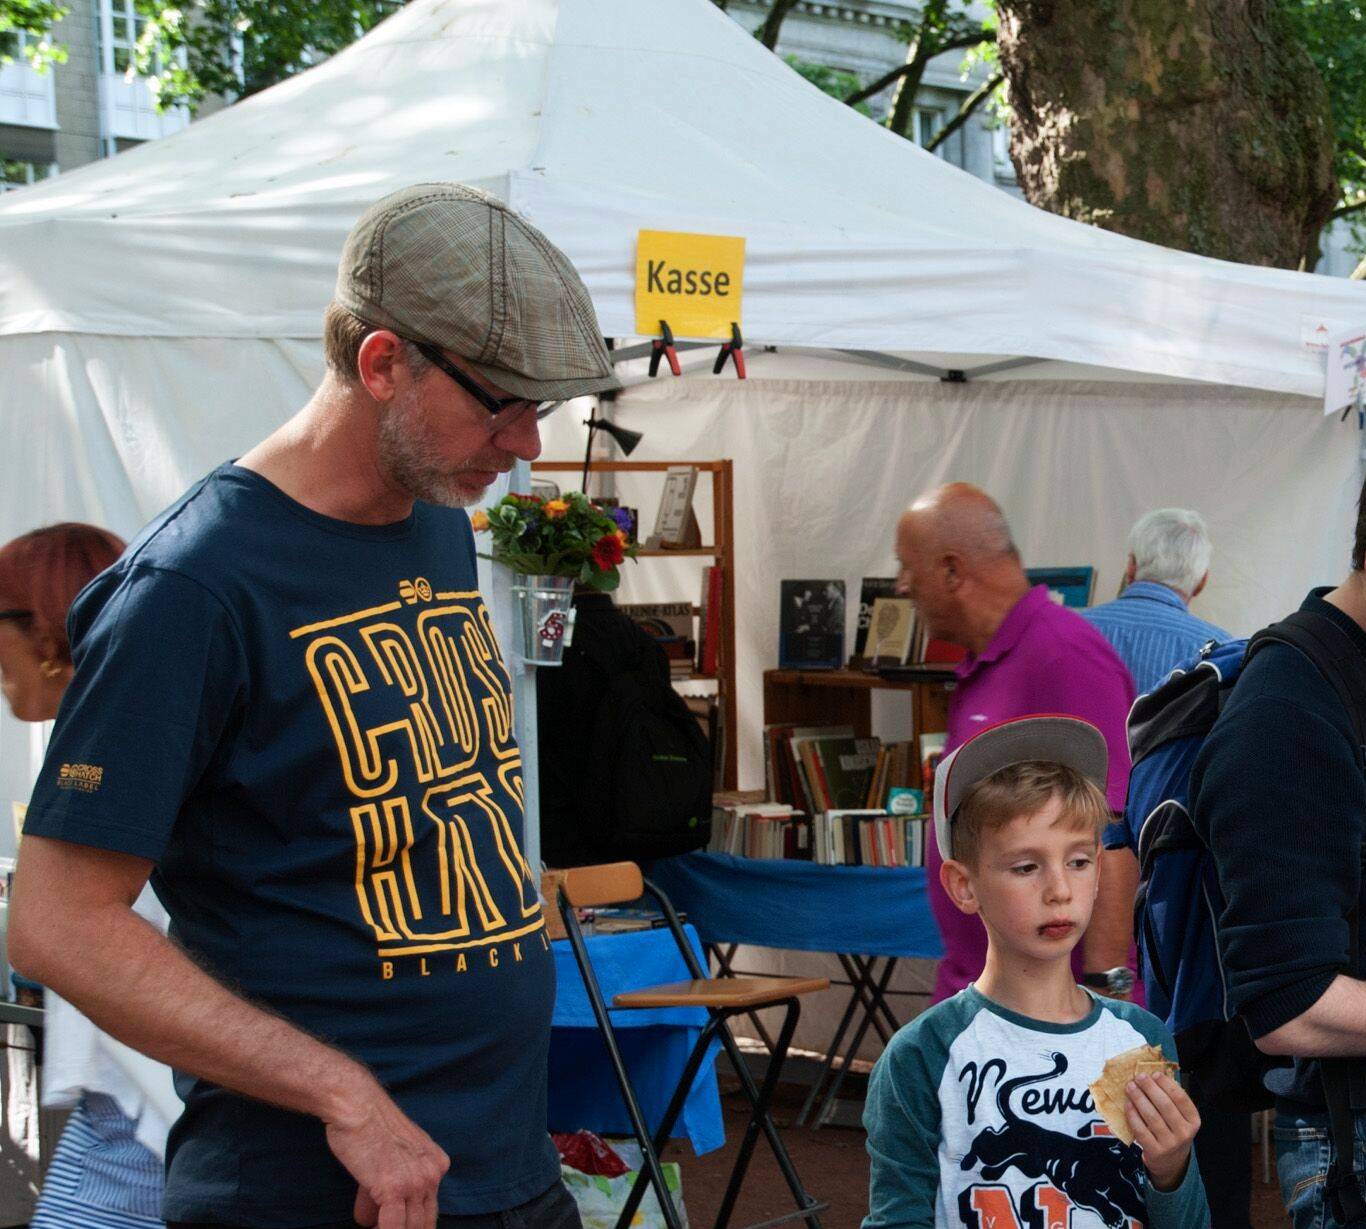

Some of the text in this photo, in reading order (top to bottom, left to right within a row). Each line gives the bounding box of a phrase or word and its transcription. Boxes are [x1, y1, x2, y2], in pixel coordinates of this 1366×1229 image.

[648, 260, 730, 296] Kasse
[305, 605, 516, 798] CROS
[349, 759, 542, 942] HAT
[382, 943, 523, 980] BLACK
[958, 1056, 1101, 1126] Newa
